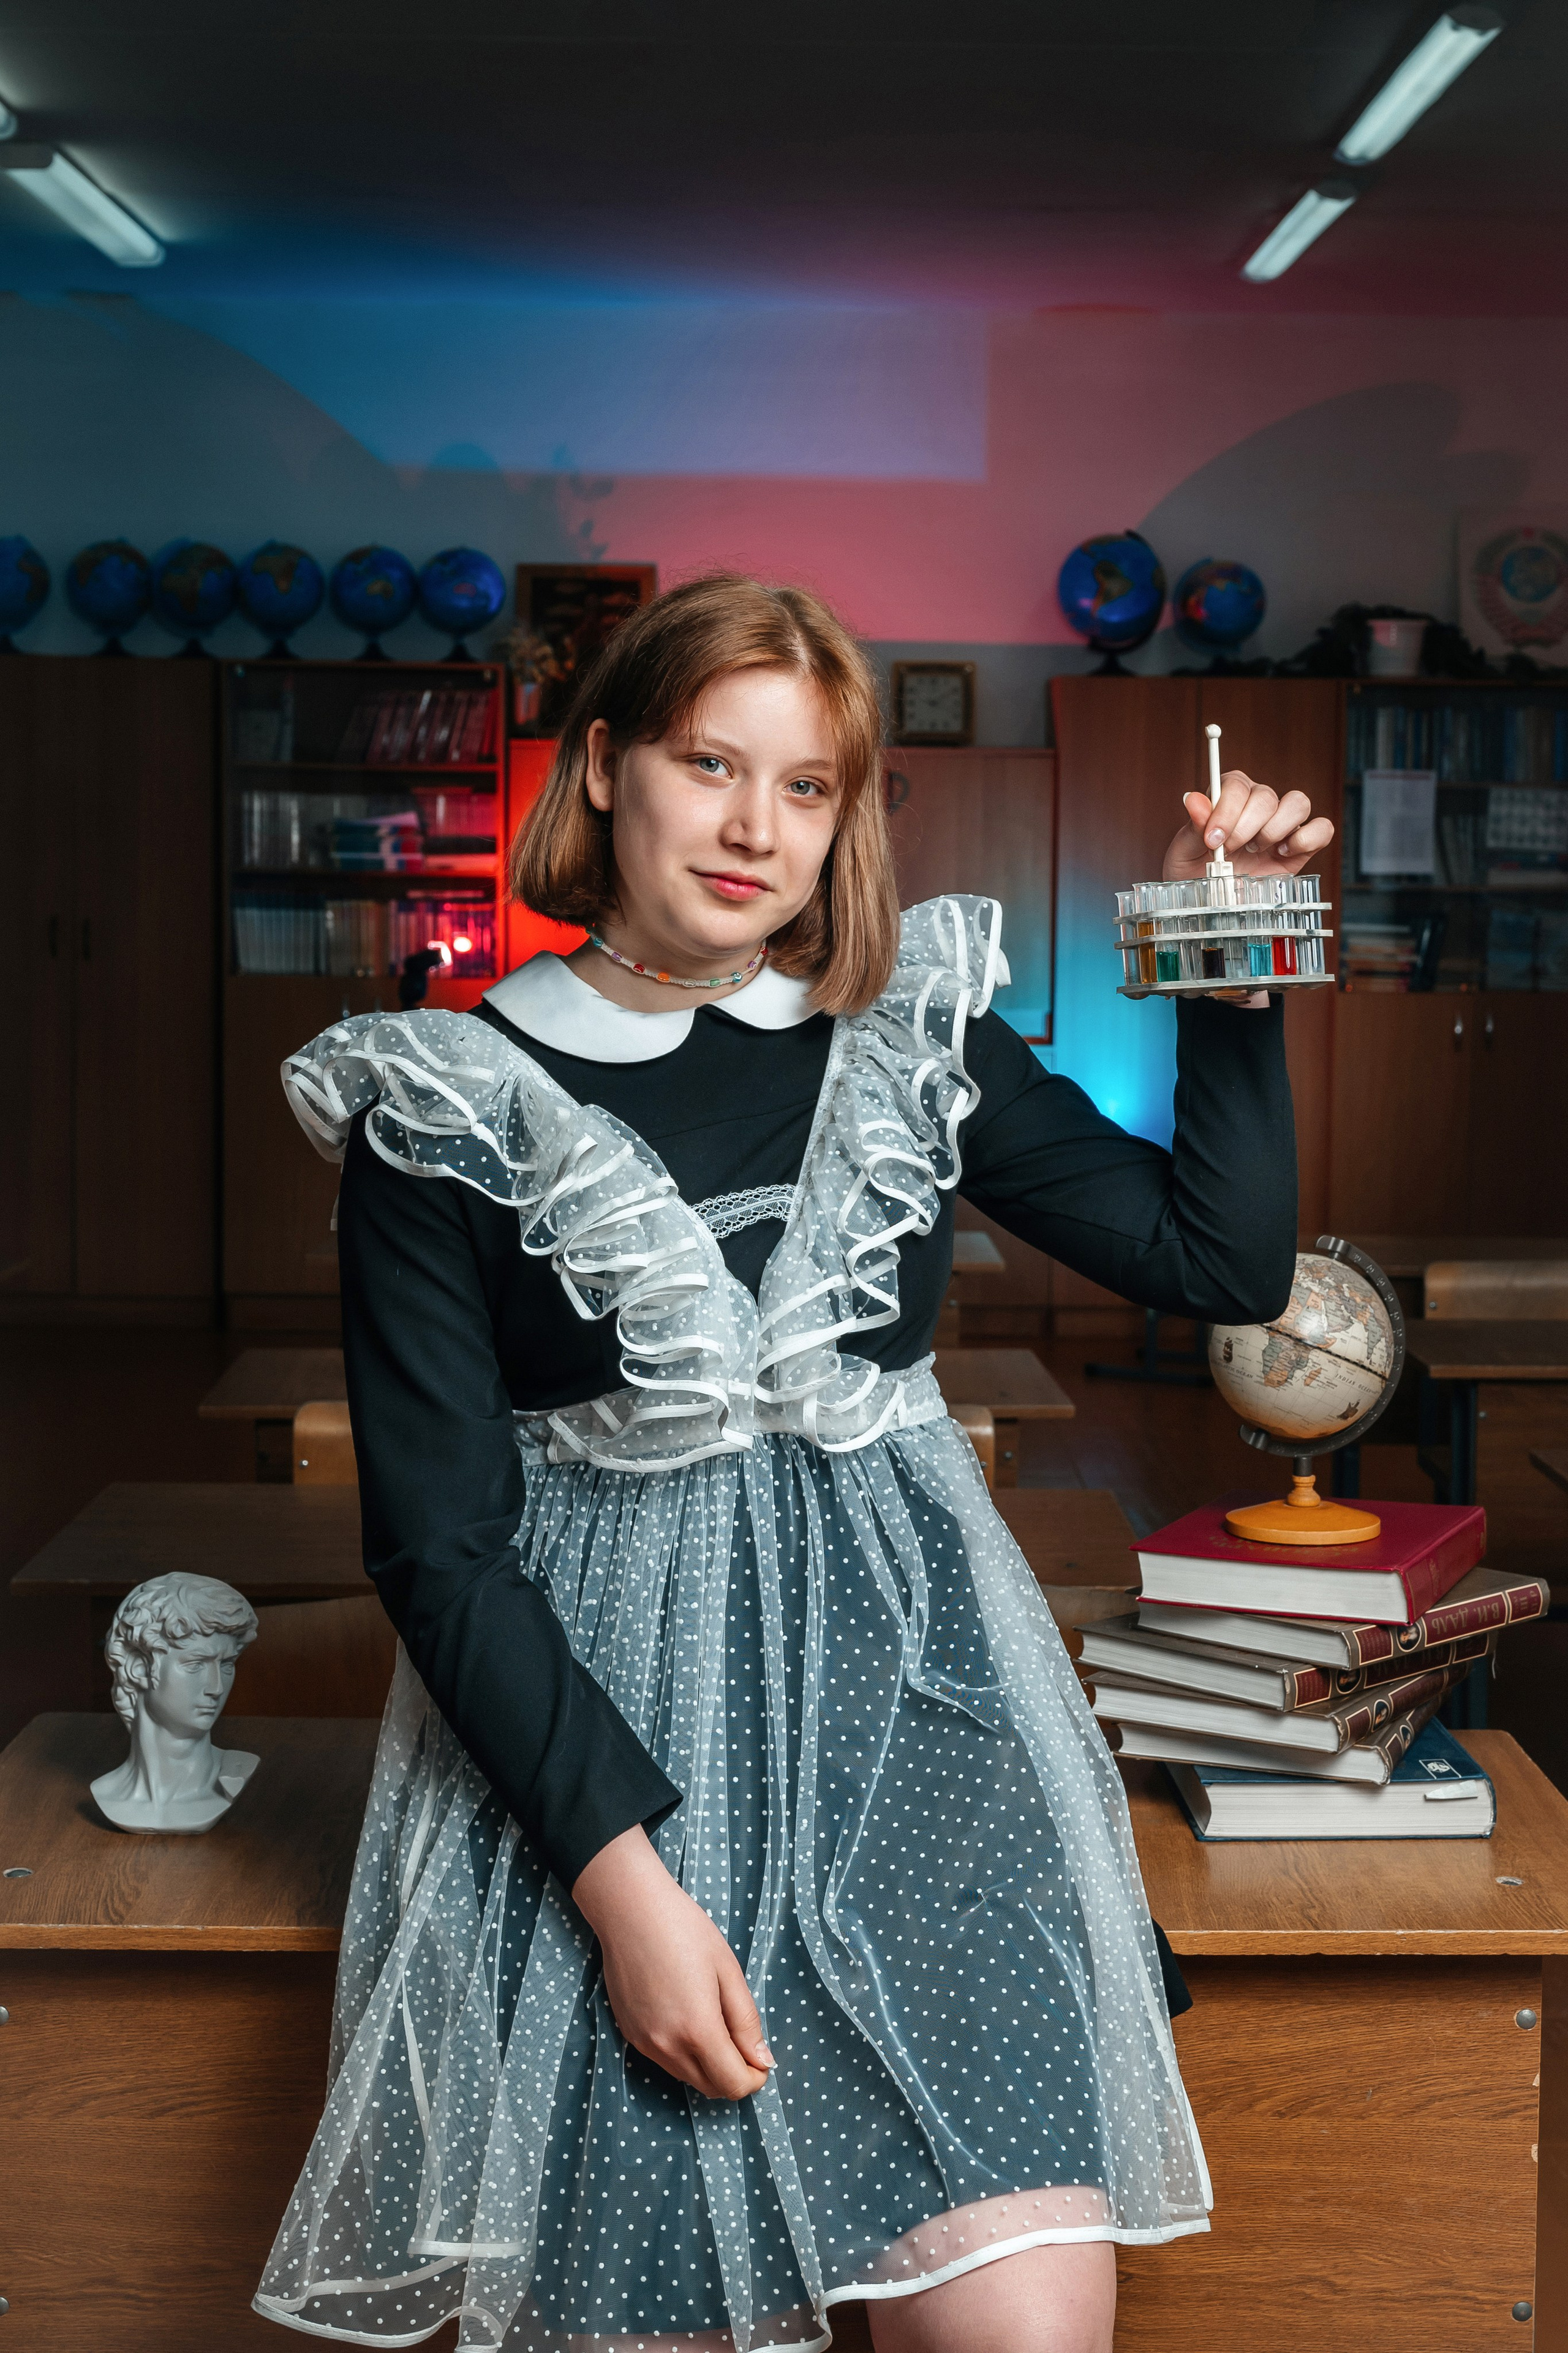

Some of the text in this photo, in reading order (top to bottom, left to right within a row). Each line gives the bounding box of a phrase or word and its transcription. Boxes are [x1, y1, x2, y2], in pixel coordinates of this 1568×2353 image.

[1335, 1373, 1356, 1386] INDIAN
[1430, 1607, 1468, 1635] ДАЛЬ
[1472, 1601, 1499, 1623] В.И.
